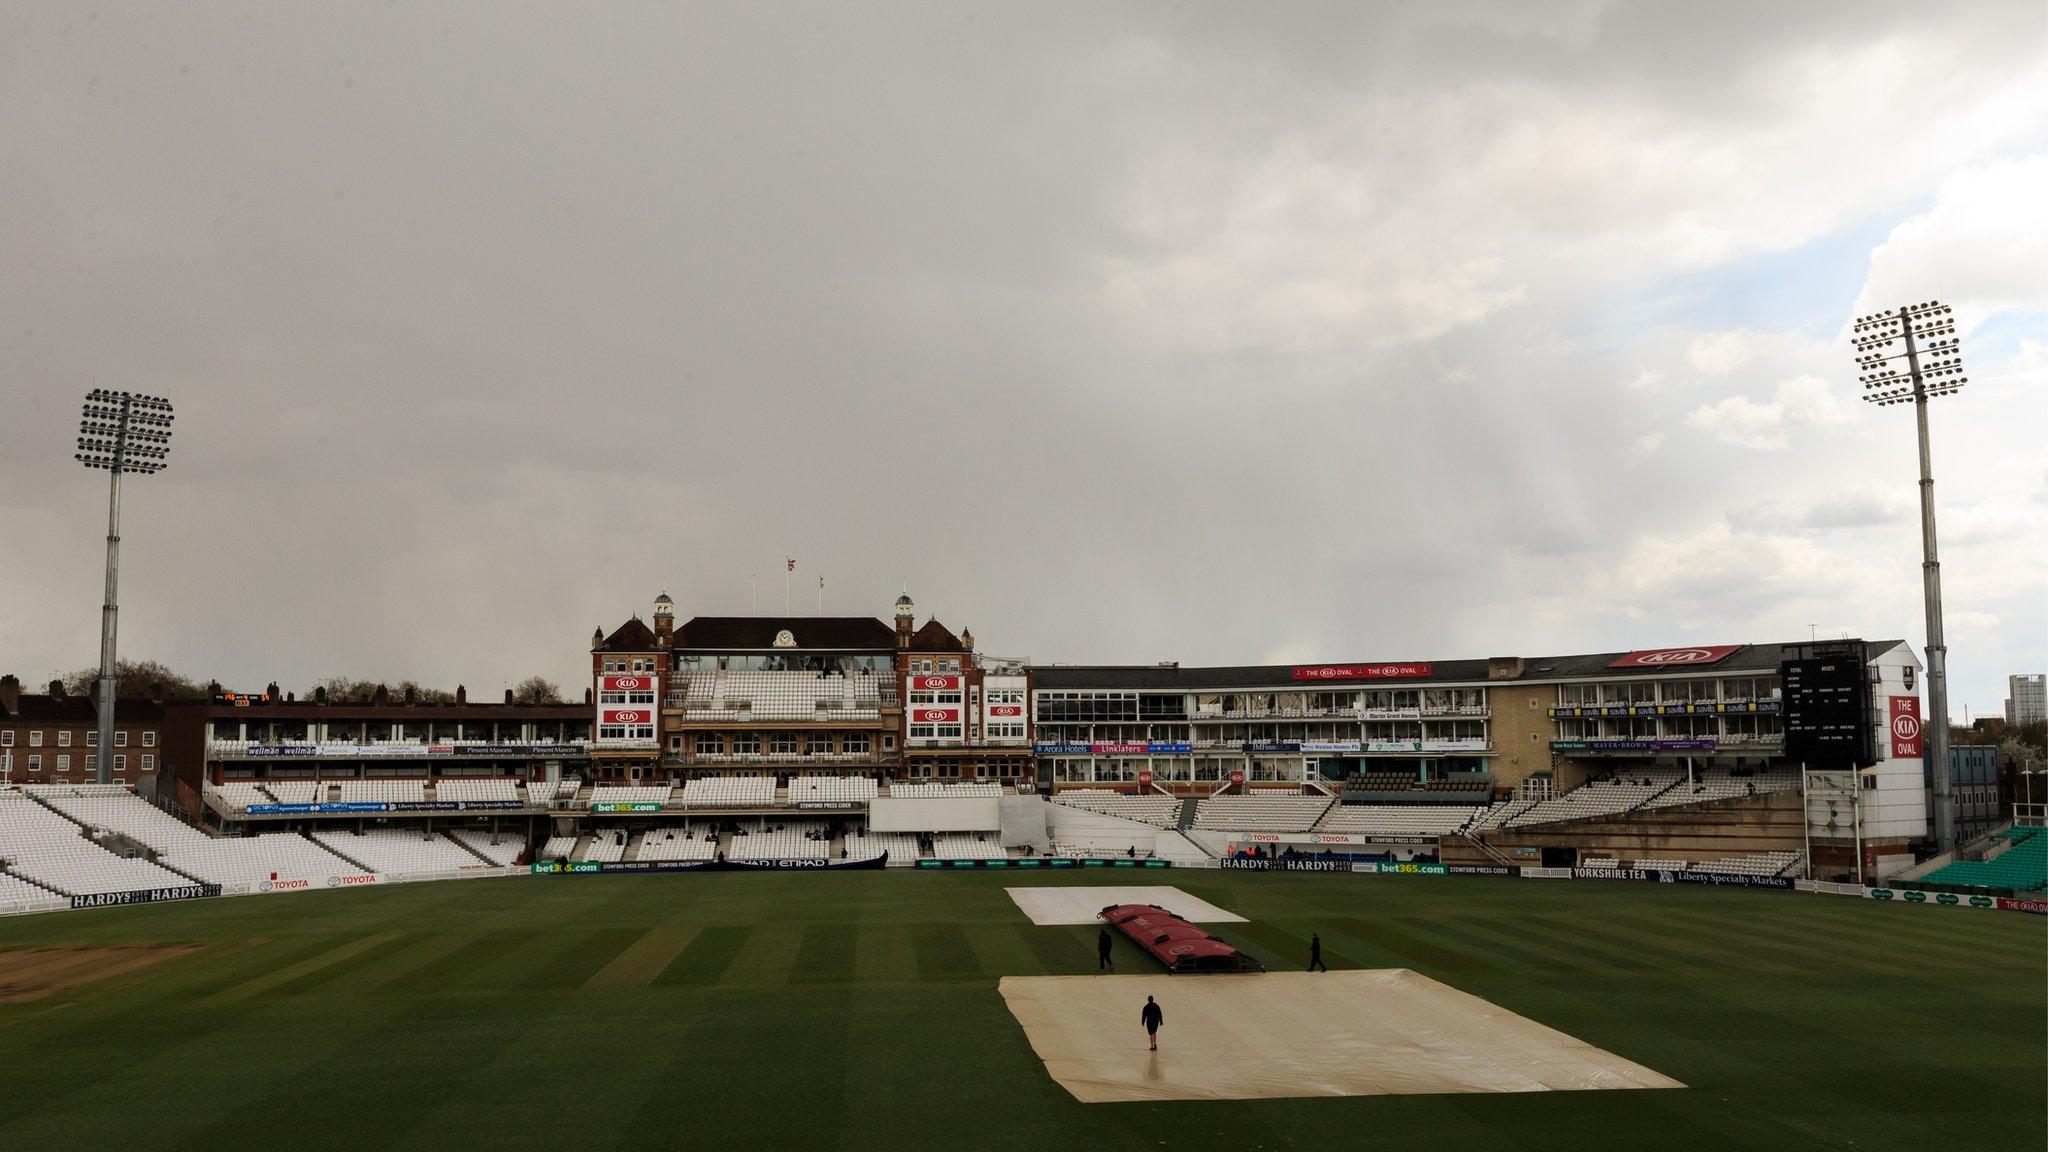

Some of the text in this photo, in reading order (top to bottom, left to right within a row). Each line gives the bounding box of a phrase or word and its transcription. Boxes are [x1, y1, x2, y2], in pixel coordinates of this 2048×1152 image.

[1647, 652, 1697, 661] KIA
[1897, 700, 1912, 710] THE
[1897, 720, 1915, 734] KIA
[1898, 744, 1916, 754] OVAL
[598, 803, 655, 812] bet365.com
[536, 864, 597, 873] bet35.com
[1222, 860, 1269, 868] HARDYS
[1287, 861, 1335, 870] HARDYS
[1382, 864, 1444, 874] bet365.com
[1575, 868, 1646, 880] YORKSHIRE TEA
[342, 875, 376, 884] TOYOTA
[1678, 872, 1787, 887] Liberty Specialty Markets
[274, 880, 309, 889] TOYOTA
[151, 886, 204, 900] HARDYS
[74, 892, 131, 907] HARDYS
[2006, 901, 2019, 910] THE
